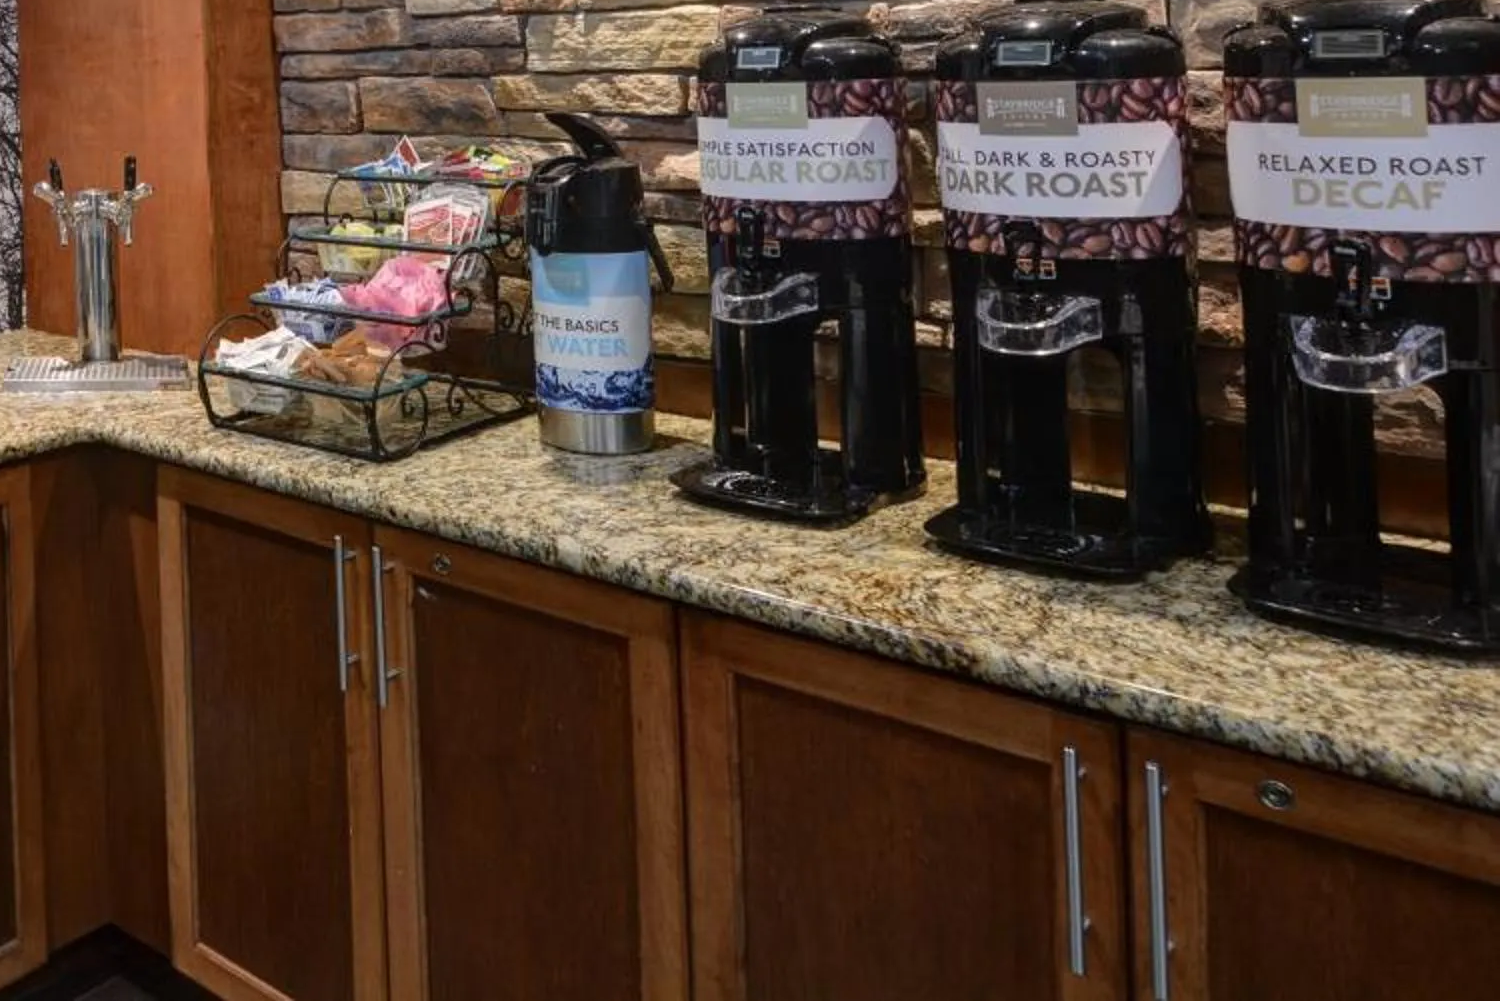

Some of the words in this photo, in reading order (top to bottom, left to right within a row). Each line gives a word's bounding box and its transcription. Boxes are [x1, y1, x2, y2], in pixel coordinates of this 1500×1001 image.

[736, 141, 875, 157] SATISFACTION
[975, 150, 1031, 168] DARK
[1039, 152, 1056, 168] &
[1065, 150, 1155, 168] ROASTY
[796, 159, 890, 183] ROAST
[1258, 153, 1378, 175] RELAXED
[1389, 156, 1487, 176] ROAST
[946, 166, 1018, 197] DARK
[1026, 172, 1149, 198] ROAST
[1291, 179, 1447, 211] DECAF
[541, 314, 562, 330] THE
[565, 318, 619, 333] BASICS
[547, 334, 629, 357] WATER
